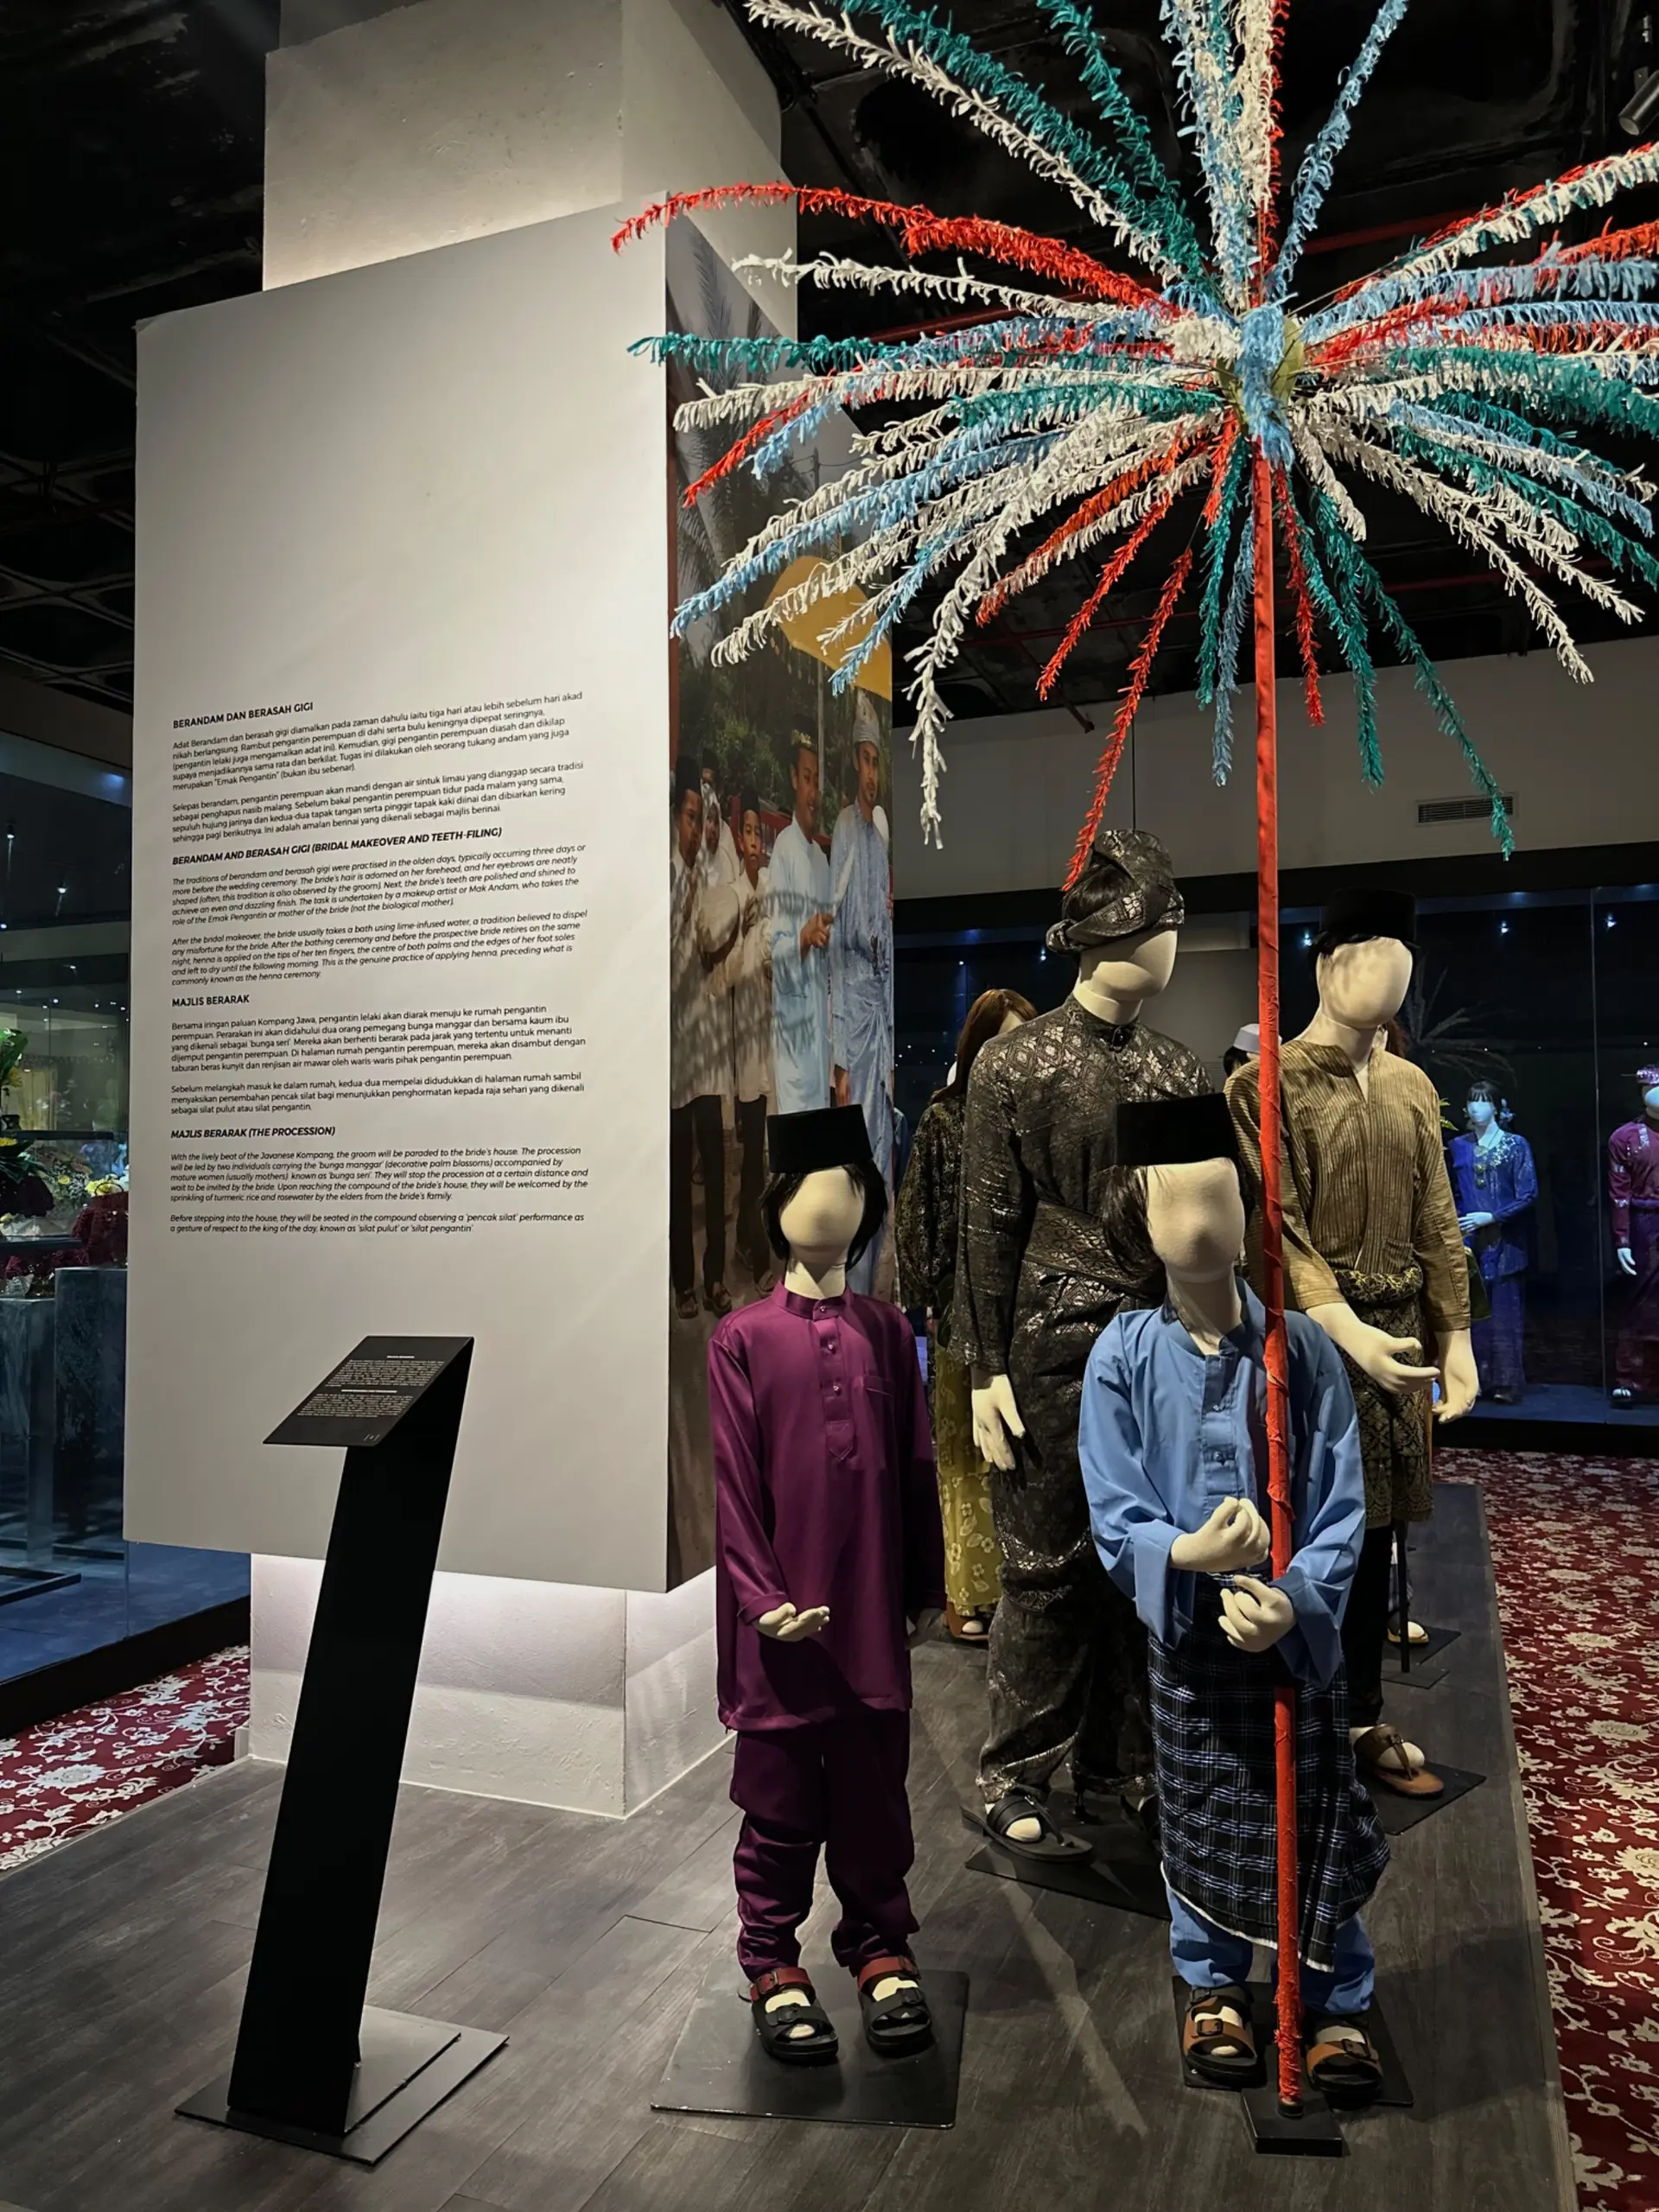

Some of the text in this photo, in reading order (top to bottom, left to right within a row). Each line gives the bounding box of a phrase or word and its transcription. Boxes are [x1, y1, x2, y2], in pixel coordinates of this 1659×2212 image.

[173, 702, 313, 728] BERANDAM DAN BERASAH GIGI
[173, 741, 189, 749] Adat
[191, 737, 227, 747] Berandam
[229, 734, 244, 742] dan
[245, 729, 274, 740] berasah
[275, 728, 289, 738] gigi
[290, 723, 330, 734] diamalkan
[331, 720, 351, 730] pada
[353, 718, 378, 727] zaman
[380, 713, 408, 723] dahulu
[429, 709, 444, 718] tiga
[446, 706, 461, 715] hari
[484, 702, 504, 711] lebih
[506, 698, 542, 708] sebelum
[562, 691, 582, 701] akad
[173, 803, 200, 811] Selepas
[240, 794, 278, 805] pengantin
[280, 790, 324, 801] perempuan
[325, 786, 344, 795] akan
[346, 783, 371, 793] mandi
[372, 781, 403, 790] dengan
[416, 776, 440, 785] sintuk
[467, 772, 486, 782] yang
[488, 769, 528, 779] dianggap
[530, 766, 556, 774] secara
[557, 762, 583, 771] tradisi
[172, 823, 200, 833] sepuluh
[201, 821, 227, 830] hujung
[228, 818, 252, 828] jarinya
[311, 809, 333, 818] tapak
[334, 808, 362, 817] tangan
[385, 802, 412, 812] pinggir
[414, 798, 436, 809] tapak
[438, 797, 454, 805] kaki
[456, 795, 479, 804] diinai
[480, 793, 496, 802] dan
[498, 790, 537, 800] dibiarkan
[539, 787, 565, 796] kering
[172, 827, 502, 865] BERANDAM AND BERASAH GIGI (BRIDAL MAKEOVER AND TEETH-FILING)
[186, 875, 219, 885] traditions
[220, 873, 228, 881] of
[228, 871, 267, 880] berandam
[268, 868, 283, 877] and
[284, 866, 315, 875] berasah
[316, 865, 330, 874] gigi
[351, 860, 388, 872] practised
[458, 852, 491, 862] typically
[493, 849, 531, 858] occurring
[172, 994, 250, 1007] MAJLIS BERARAK
[203, 1020, 229, 1029] iringan
[231, 1019, 256, 1028] paluan
[257, 1018, 295, 1027] Kompang
[319, 1014, 359, 1024] pengantin
[403, 1010, 428, 1019] diarak
[429, 1009, 461, 1018] menuju
[474, 1007, 501, 1015] rumah
[504, 1006, 546, 1015] pengantin
[204, 1083, 245, 1093] melangkah
[382, 1077, 423, 1087] mempelai
[423, 1076, 473, 1084] didudukkan
[553, 1071, 581, 1080] sambil
[171, 1095, 218, 1105] menyaksikan
[219, 1093, 270, 1103] persembahan
[270, 1092, 298, 1103] pencak
[317, 1091, 334, 1101] bagi
[336, 1090, 390, 1099] menunjukkan
[391, 1089, 452, 1098] penghormatan
[454, 1086, 484, 1096] kepada
[486, 1086, 500, 1095] raja
[502, 1085, 527, 1094] sehari
[550, 1084, 584, 1092] dikenali
[170, 1126, 335, 1138] MAJLIS BERARAK (THE PROCESSION)
[201, 1153, 219, 1162] lively
[350, 1151, 376, 1160] groom
[404, 1148, 439, 1159] paraded
[537, 1147, 581, 1156] procession
[170, 1193, 204, 1203] sprinkling
[213, 1193, 245, 1203] turmeric
[260, 1192, 276, 1201] and
[315, 1192, 325, 1202] by
